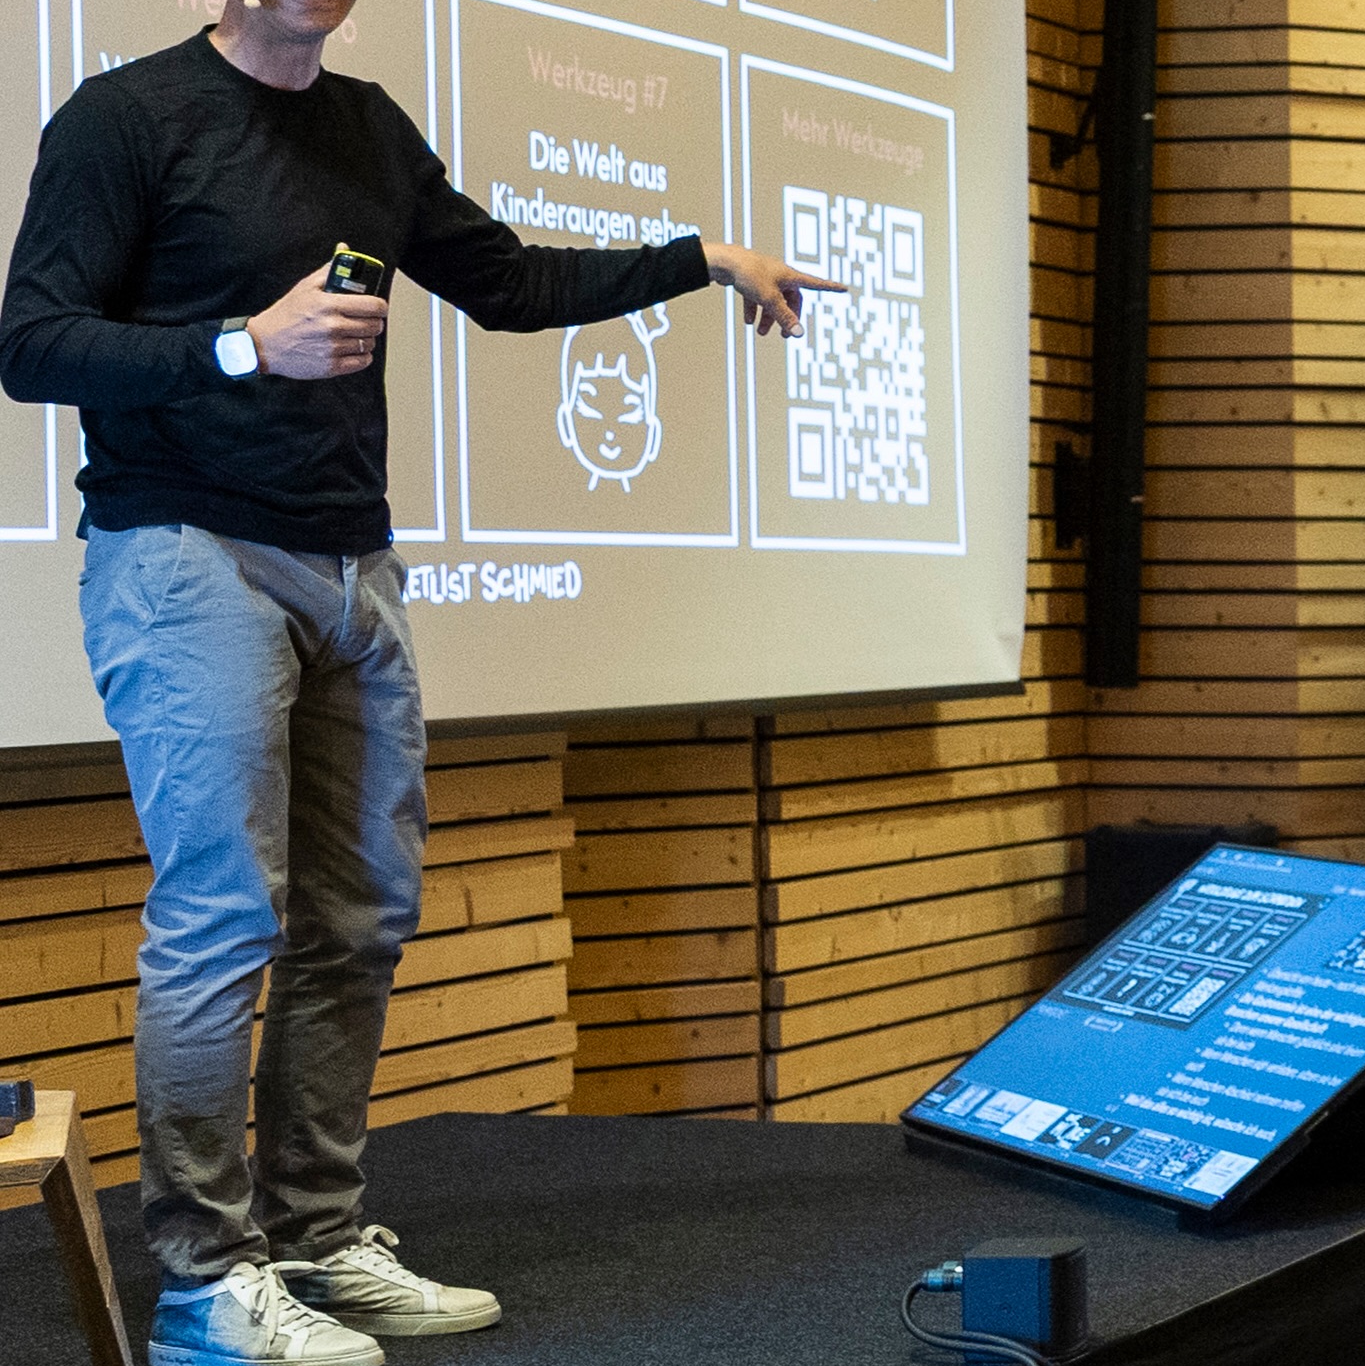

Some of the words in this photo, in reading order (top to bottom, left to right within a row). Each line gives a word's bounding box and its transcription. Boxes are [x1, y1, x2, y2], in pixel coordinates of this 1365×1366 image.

[528, 46, 637, 115] Werkzeug
[644, 74, 668, 109] #7
[782, 106, 828, 147] Mehr
[529, 130, 570, 175] Die
[572, 138, 626, 184] Welt
[629, 160, 668, 192] aus
[490, 181, 636, 249] Kinderaugen
[402, 562, 477, 605] ETLIST
[479, 560, 582, 604] SCHMIED
